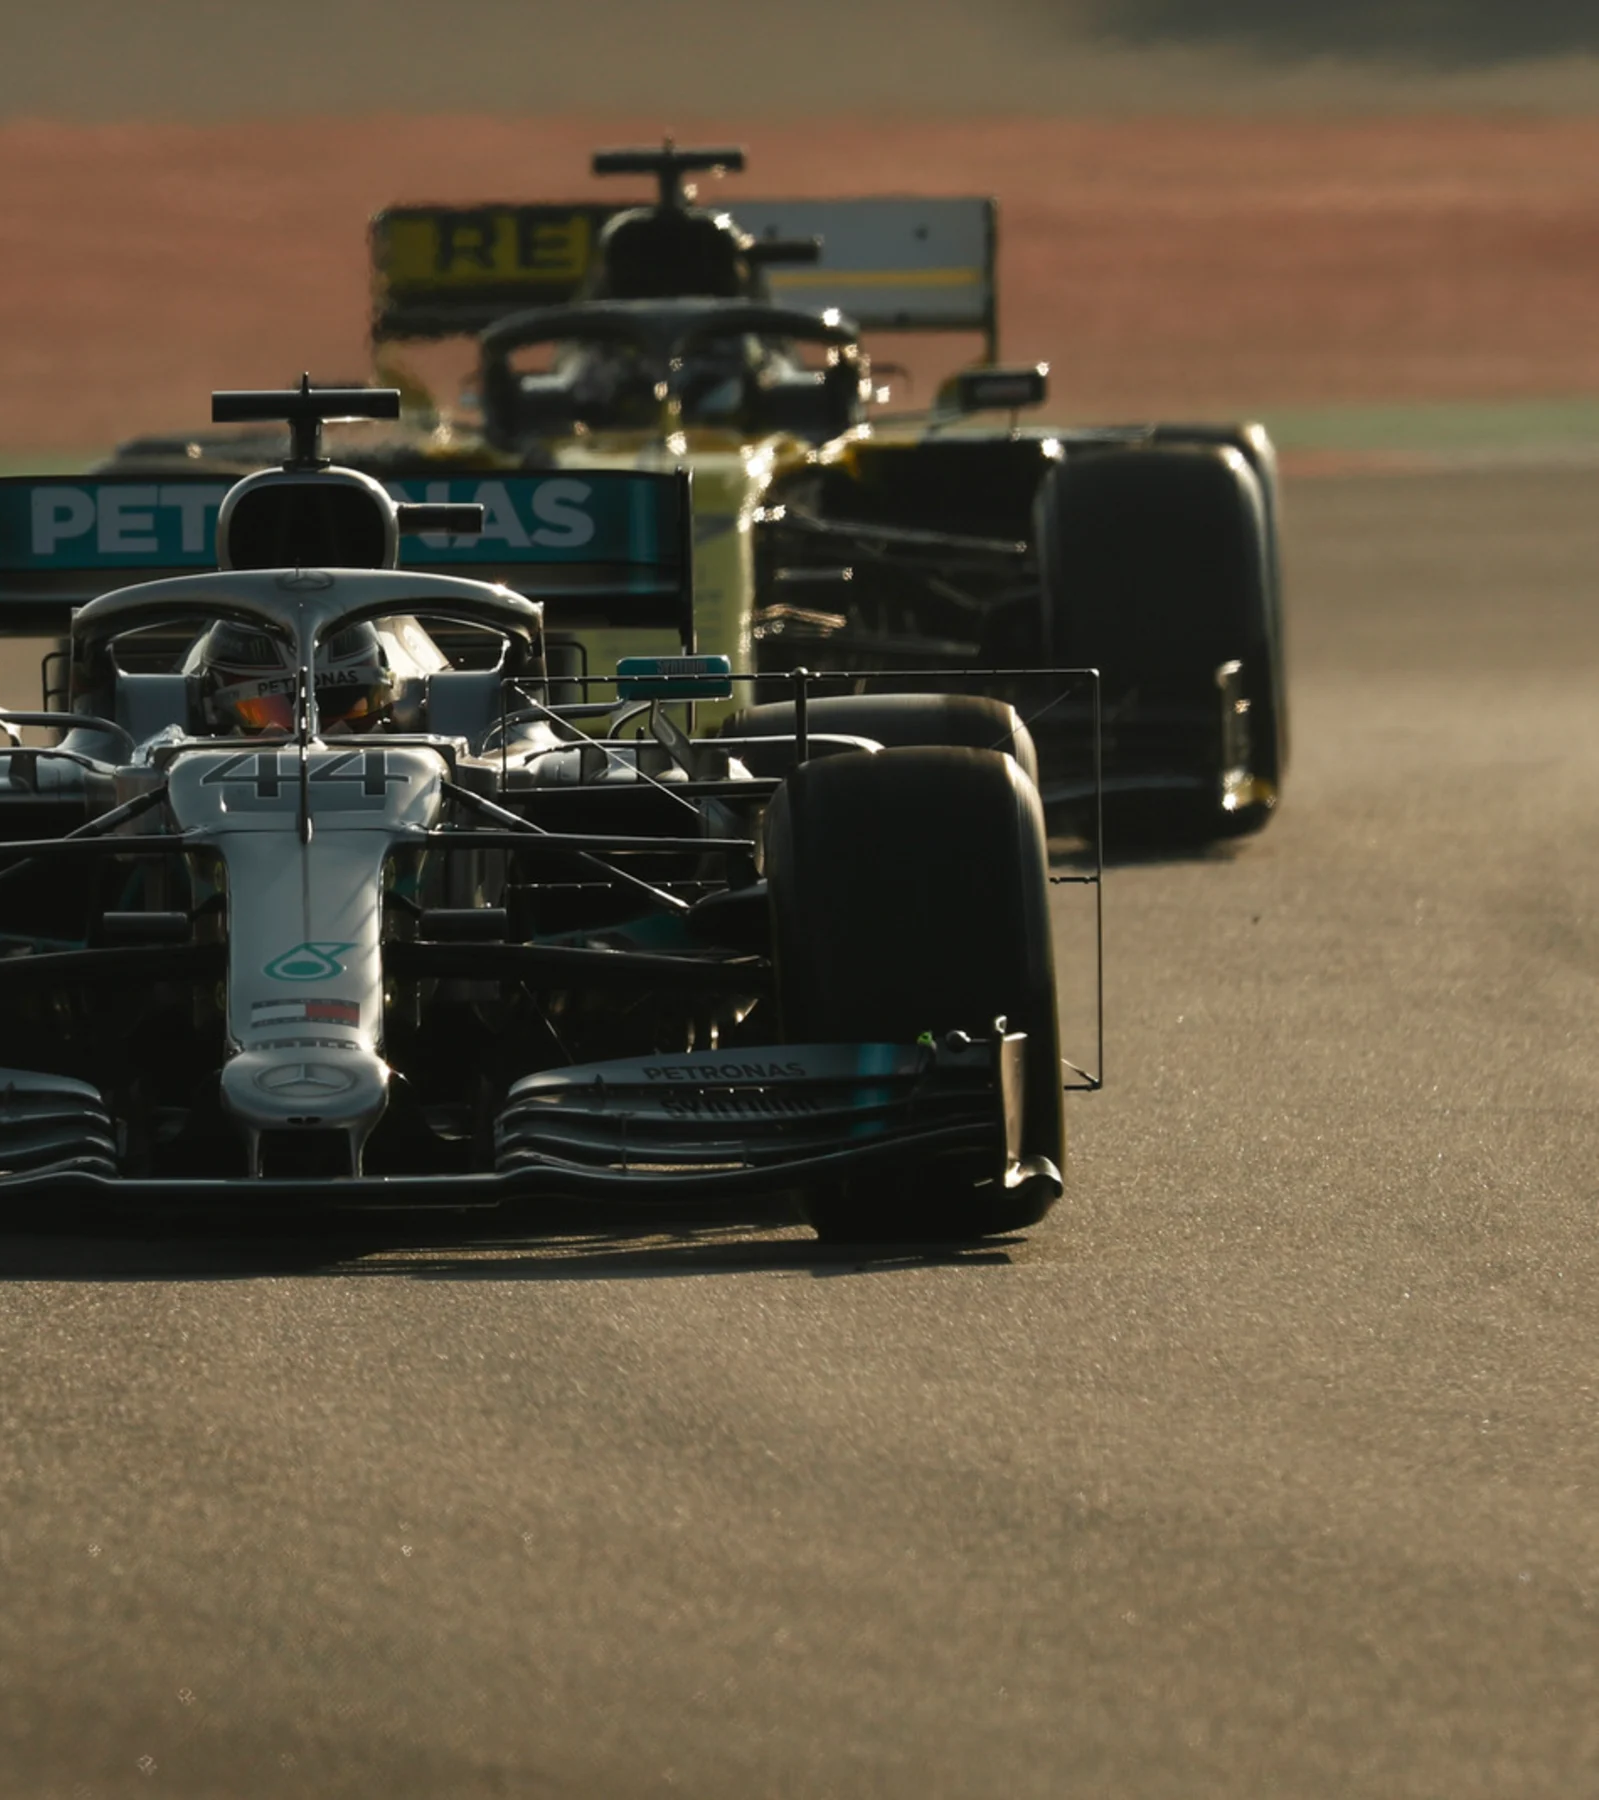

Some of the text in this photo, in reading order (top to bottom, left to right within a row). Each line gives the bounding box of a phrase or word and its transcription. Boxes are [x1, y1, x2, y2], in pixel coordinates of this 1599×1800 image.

[31, 478, 595, 555] PETAS
[257, 669, 359, 697] PETNAS
[200, 750, 412, 799] 44
[642, 1062, 807, 1081] PETRONAS
